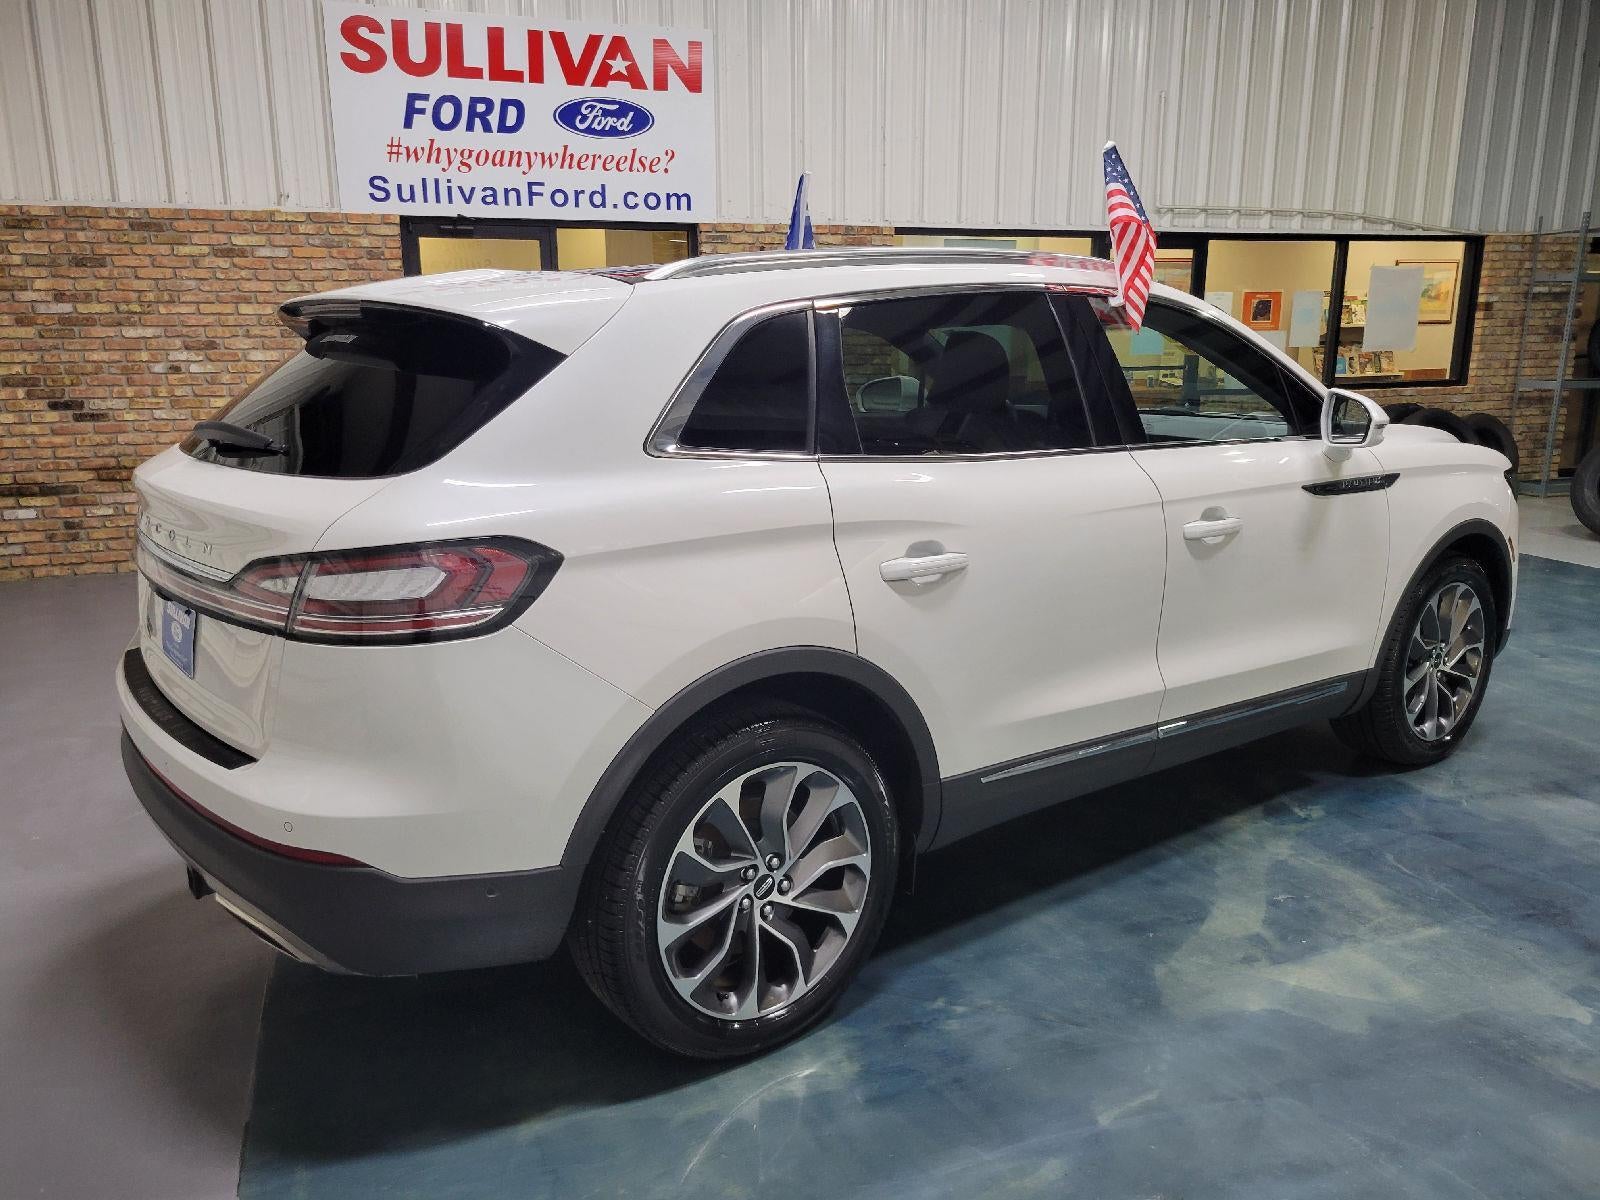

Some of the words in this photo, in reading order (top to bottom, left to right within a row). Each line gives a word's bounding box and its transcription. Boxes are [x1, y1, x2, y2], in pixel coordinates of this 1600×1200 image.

[339, 14, 703, 94] SULLIVAN
[403, 92, 526, 134] FORD
[575, 101, 635, 132] Ford
[386, 137, 675, 176] #whygoanywhereelse?
[368, 175, 693, 212] SullivanFord.com
